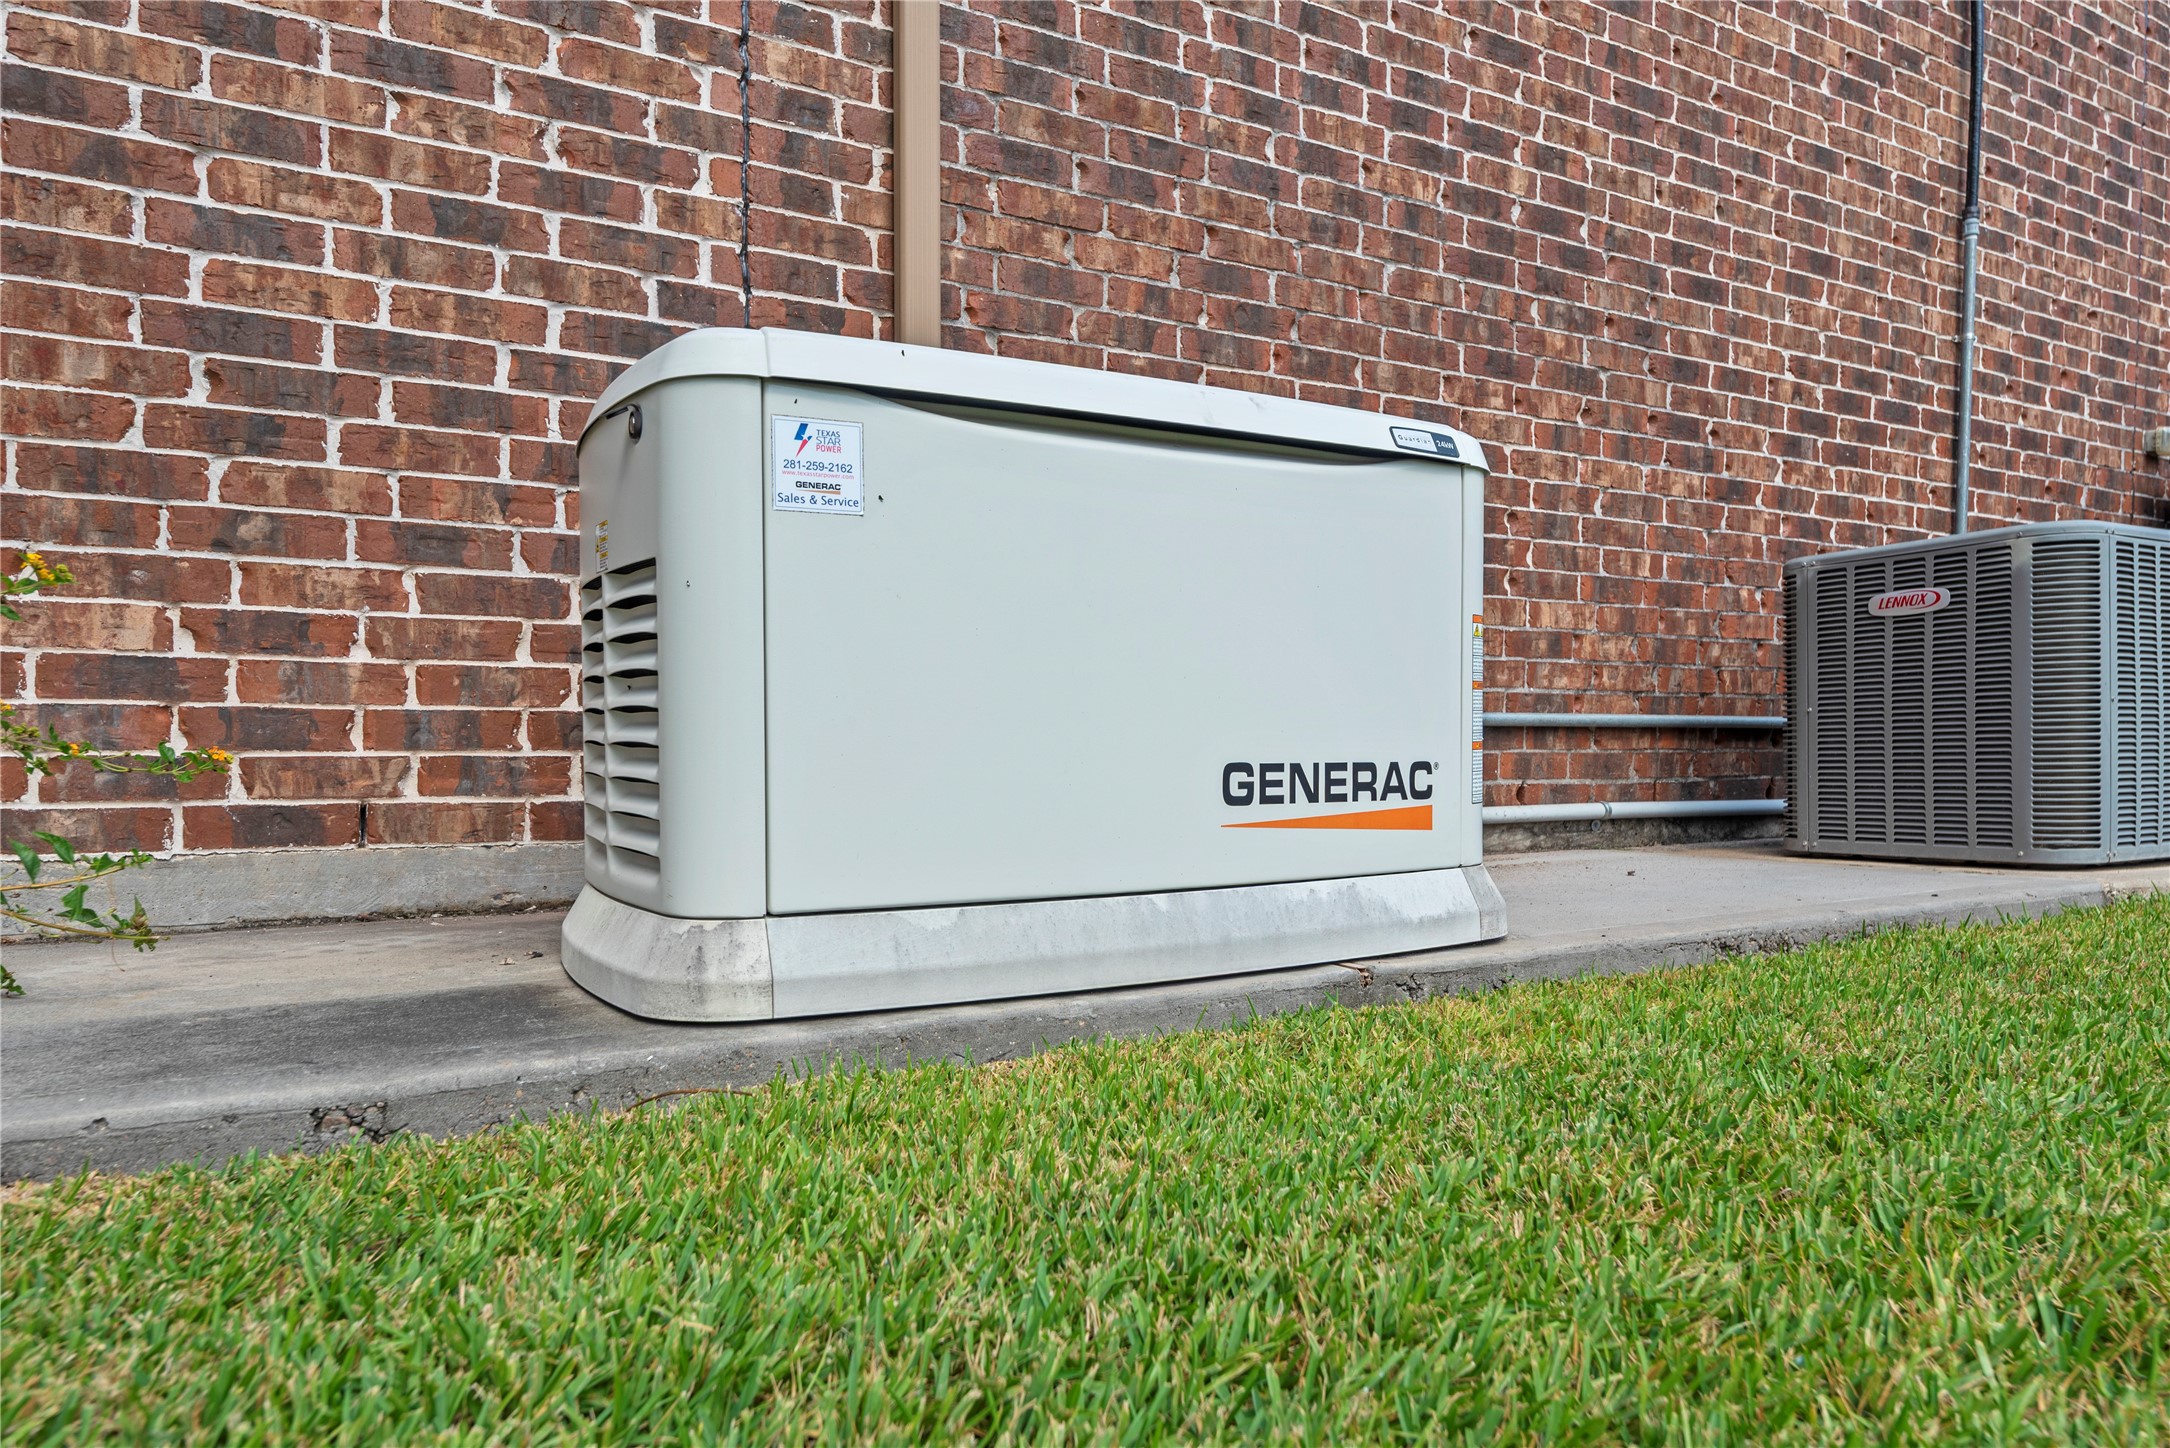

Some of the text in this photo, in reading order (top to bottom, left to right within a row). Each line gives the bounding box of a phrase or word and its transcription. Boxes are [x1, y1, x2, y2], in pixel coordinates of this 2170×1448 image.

[816, 429, 840, 438] TEXAS
[816, 436, 841, 446] STAR
[816, 444, 841, 453] POWER
[783, 459, 853, 473] 281-259-2162
[781, 470, 855, 480] www.texasstarpower.com
[795, 480, 841, 491] GENERAC
[777, 492, 859, 508] Sales & Service
[1878, 593, 1928, 610] LENNOX
